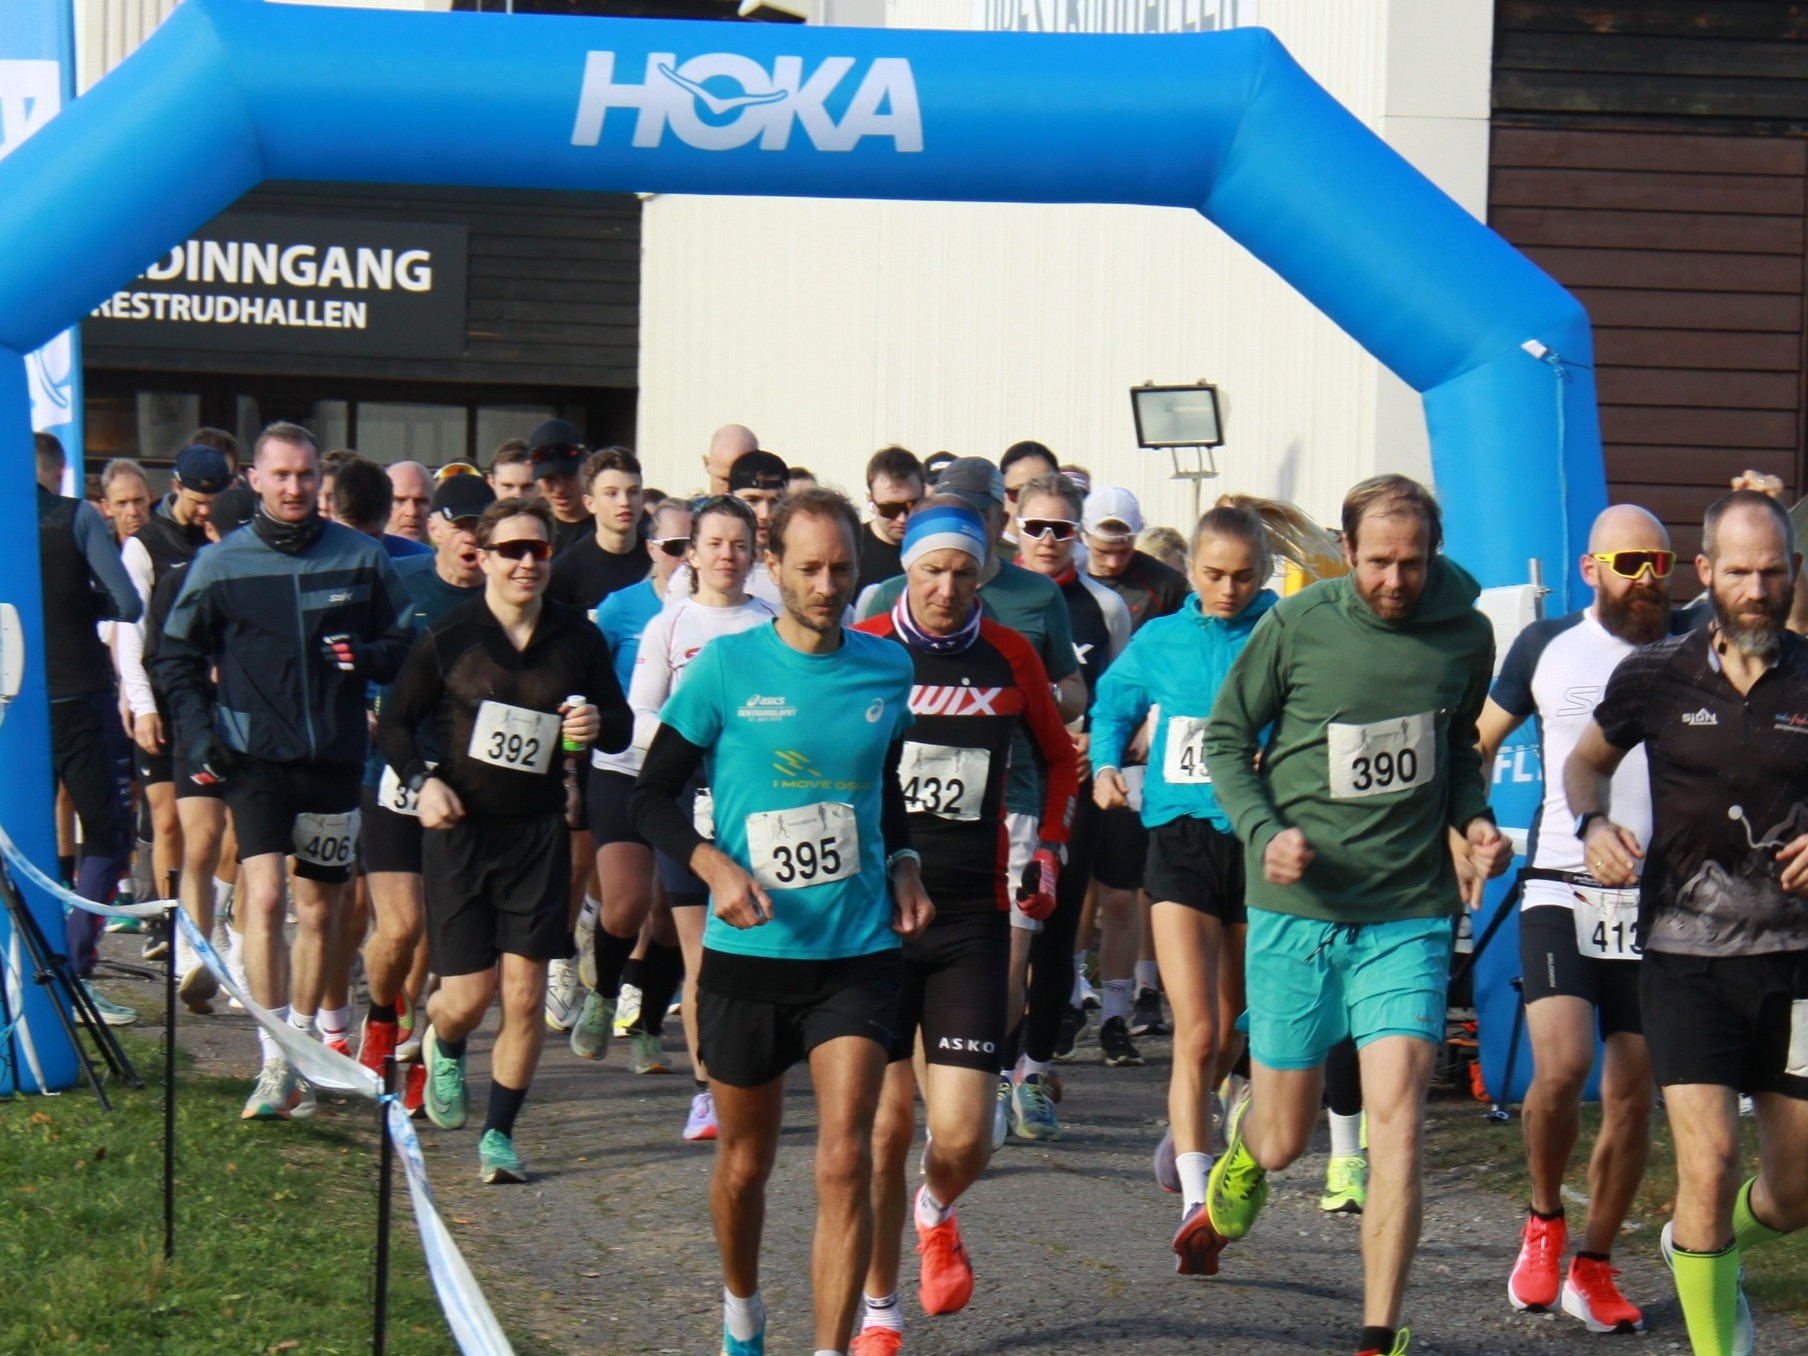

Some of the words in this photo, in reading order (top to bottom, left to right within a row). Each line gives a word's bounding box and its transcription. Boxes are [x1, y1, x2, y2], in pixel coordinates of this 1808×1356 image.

[570, 50, 924, 152] HOKA
[137, 240, 432, 292] DINNGANG
[488, 731, 539, 767] 392
[781, 780, 832, 790] MOVE
[1352, 748, 1417, 791] 390
[902, 776, 964, 813] 432
[306, 836, 350, 862] 406
[773, 836, 841, 883] 395
[939, 1037, 995, 1053] ASKO
